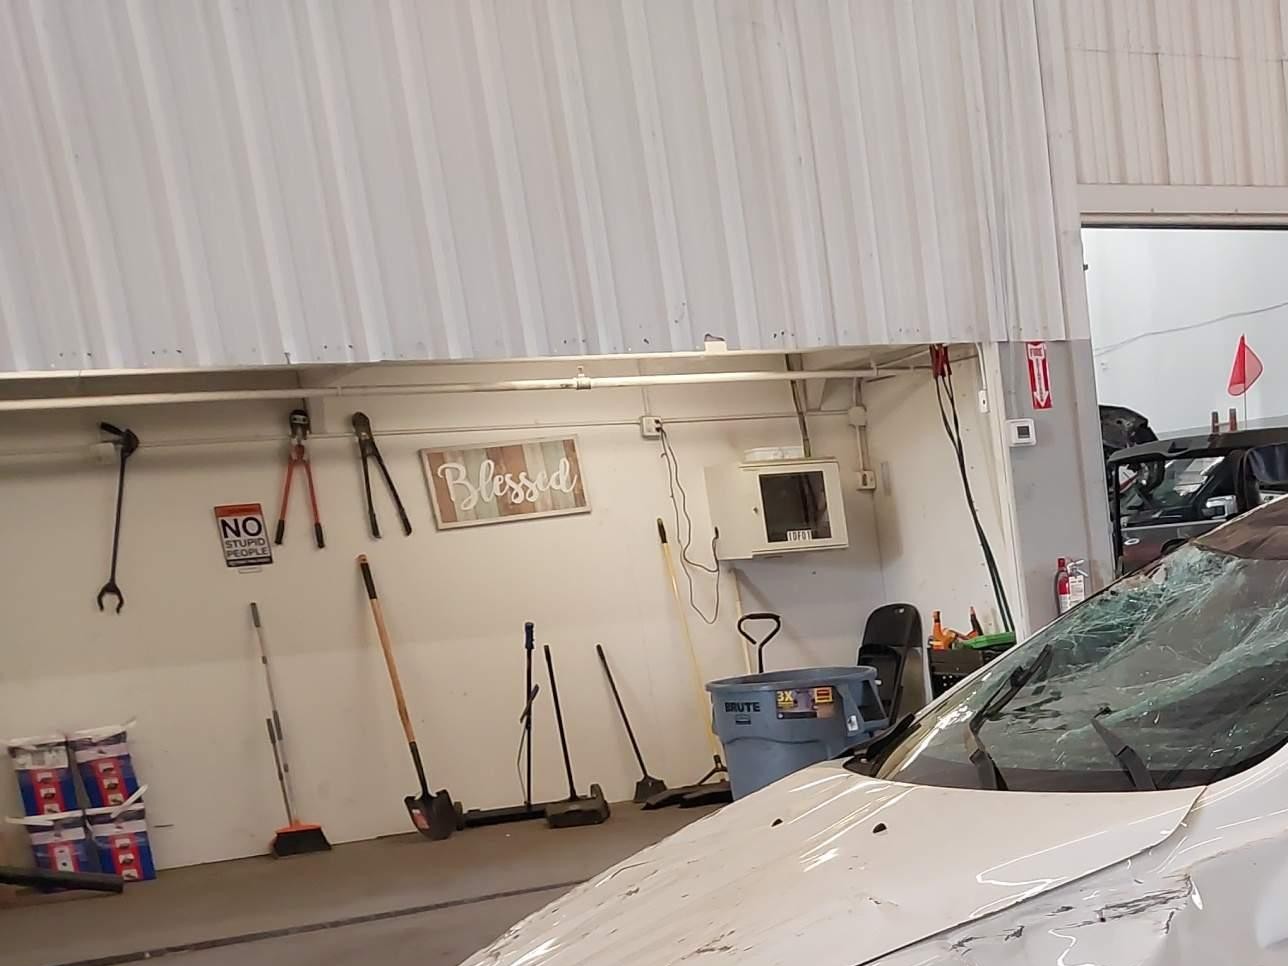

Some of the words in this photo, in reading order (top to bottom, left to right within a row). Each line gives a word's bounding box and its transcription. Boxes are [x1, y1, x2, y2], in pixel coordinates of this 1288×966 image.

[437, 458, 578, 511] Blessed
[221, 516, 262, 538] NO
[225, 538, 266, 549] STUPID
[226, 547, 269, 558] PEOPLE
[777, 690, 794, 702] 3X
[725, 702, 761, 713] BRUTE
